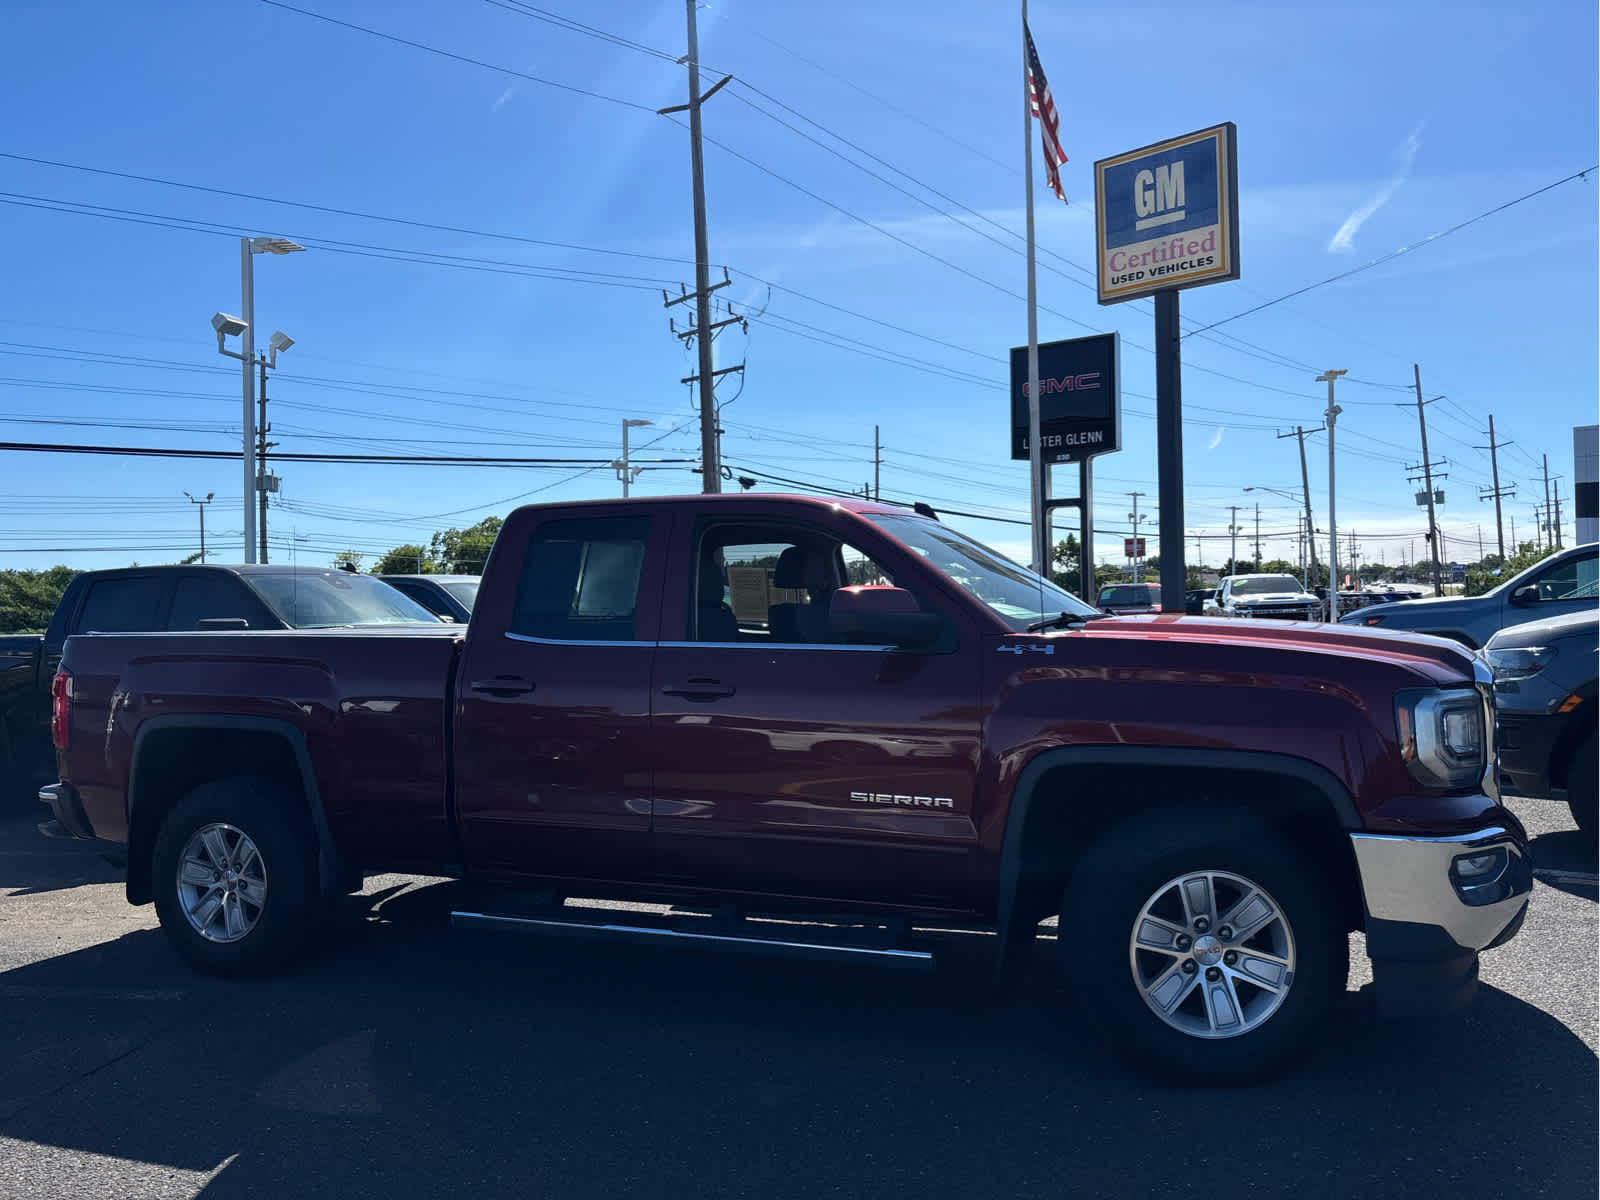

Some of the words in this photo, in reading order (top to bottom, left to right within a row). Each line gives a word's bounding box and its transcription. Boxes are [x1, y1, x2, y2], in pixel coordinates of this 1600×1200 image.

[1134, 160, 1185, 218] GM
[1109, 231, 1216, 272] Certified
[1111, 271, 1145, 285] USED
[1148, 256, 1214, 277] VEHICLES
[1023, 434, 1062, 449] LTER
[1066, 431, 1103, 445] GLENN
[850, 791, 954, 808] SIERRA
